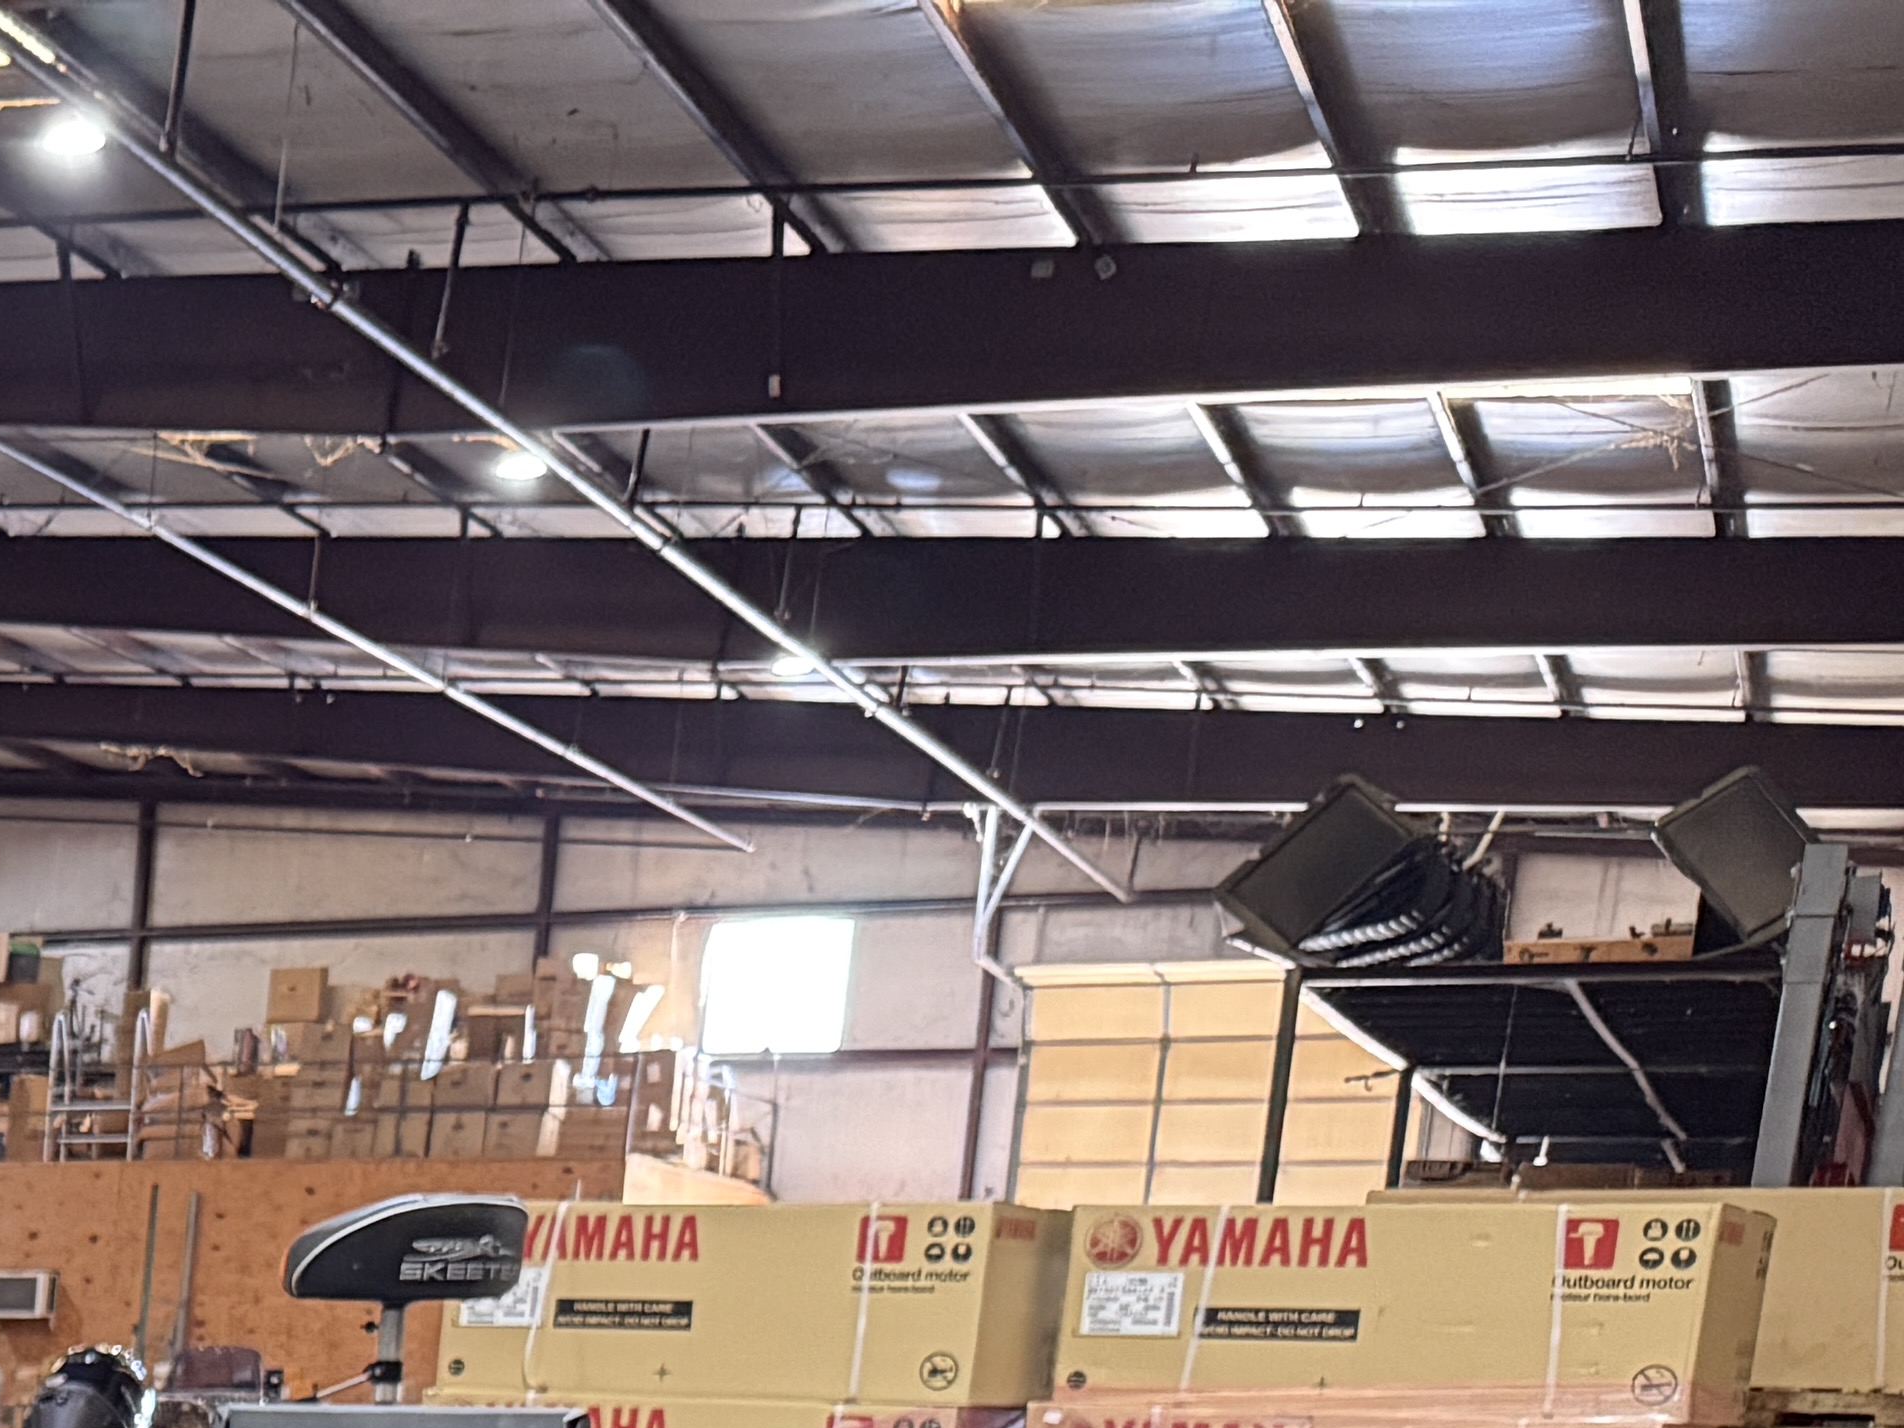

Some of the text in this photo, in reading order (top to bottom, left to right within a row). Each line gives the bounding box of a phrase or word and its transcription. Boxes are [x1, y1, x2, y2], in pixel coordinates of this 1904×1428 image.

[523, 1214, 699, 1262] YAMAHA
[1152, 1216, 1368, 1268] YAMAHA
[399, 1261, 521, 1282] SKEETE
[925, 1270, 970, 1283] motor
[1639, 1276, 1694, 1291] motor
[1217, 1310, 1337, 1324] HANDLE WITH CARE
